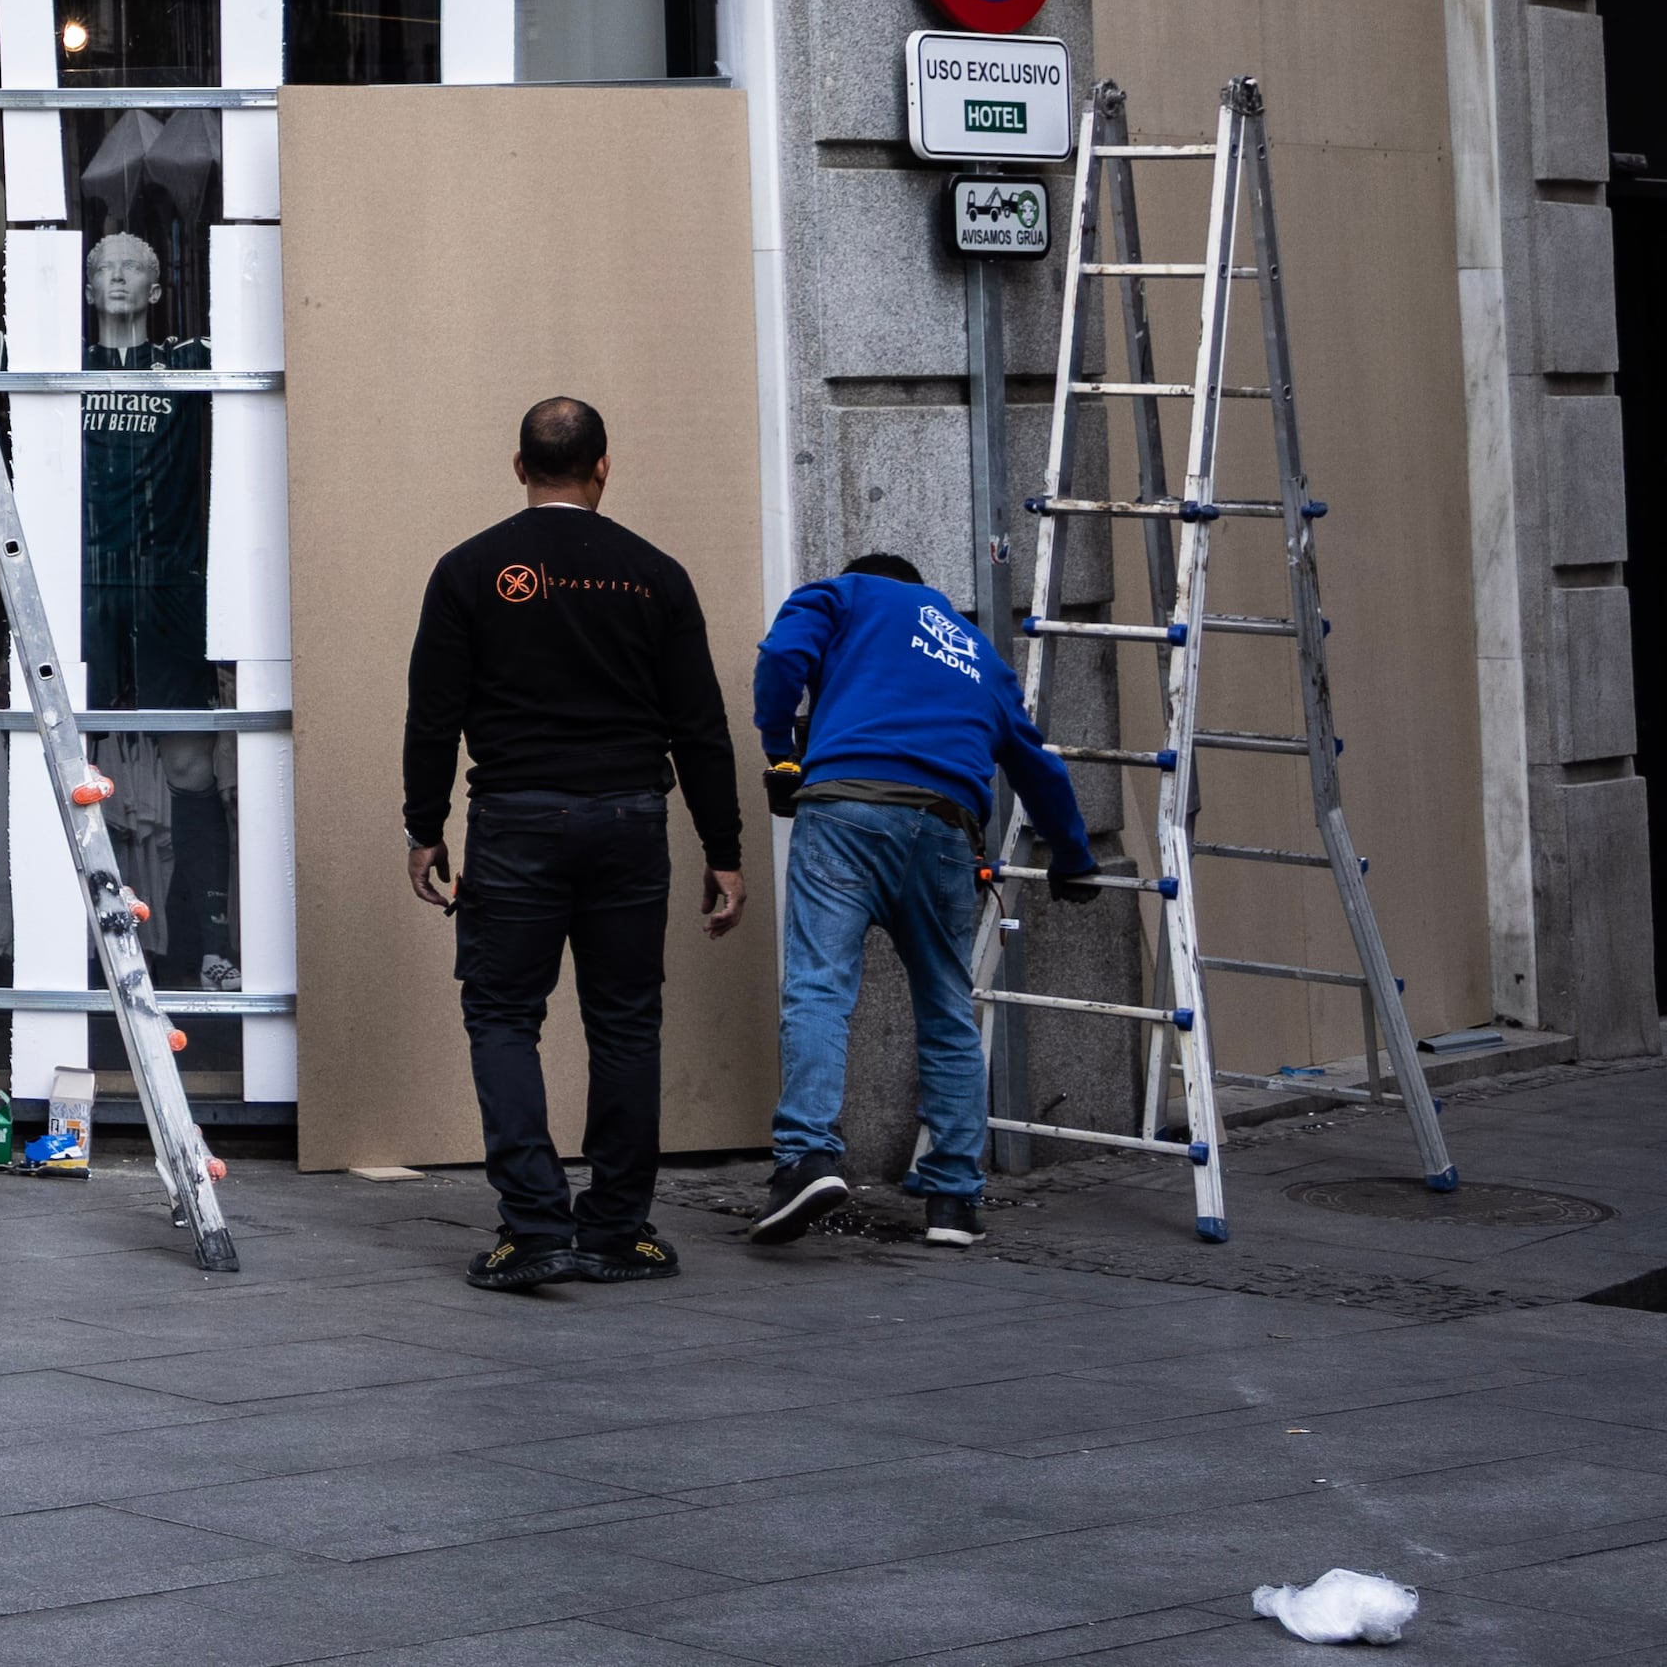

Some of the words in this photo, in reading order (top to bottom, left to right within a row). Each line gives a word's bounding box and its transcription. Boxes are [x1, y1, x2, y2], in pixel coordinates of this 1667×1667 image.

[927, 59, 962, 81] USO
[967, 61, 1061, 86] EXCLUSIVO
[967, 105, 1024, 129] HOTEL
[961, 229, 1012, 245] AVISAMOS
[80, 390, 172, 414] mirates
[83, 413, 105, 431] FLY
[108, 413, 157, 433] BETTER
[548, 577, 651, 598] SPASVITAL
[911, 635, 981, 684] PLADUR
